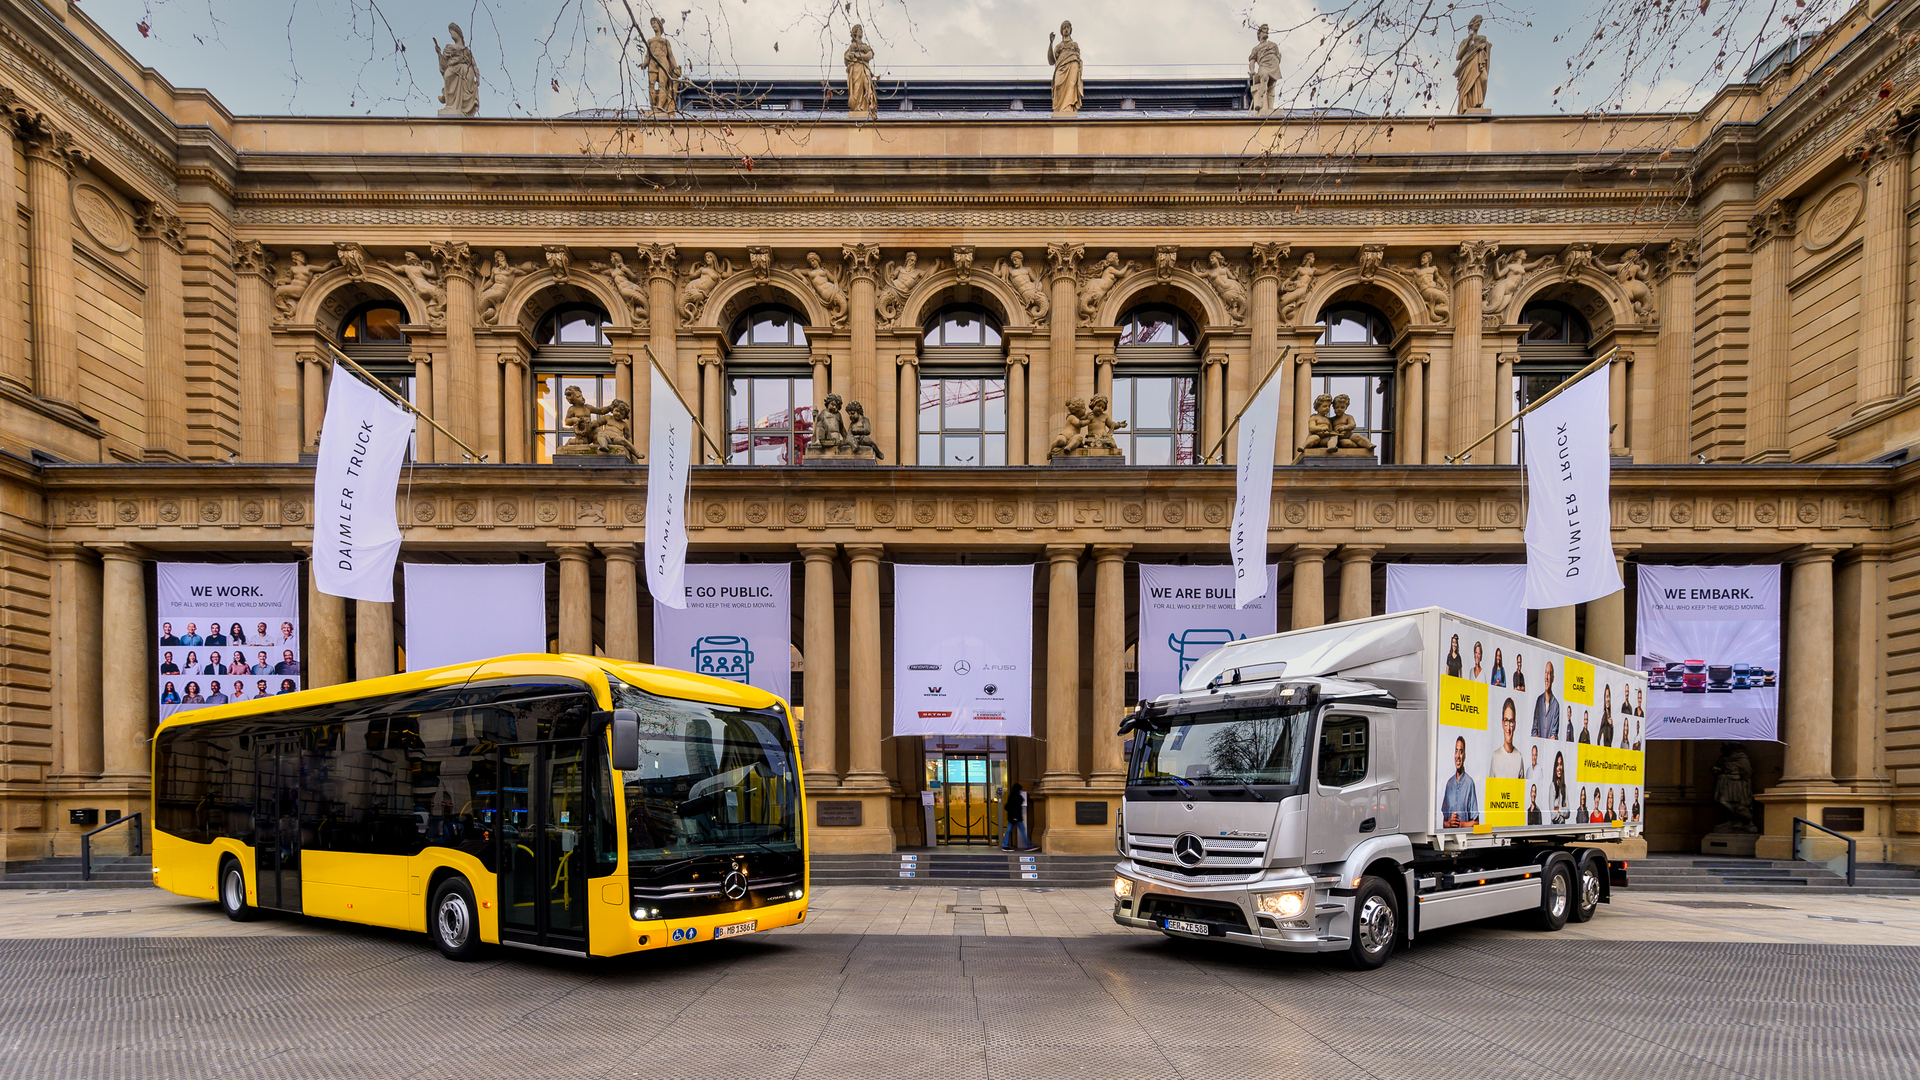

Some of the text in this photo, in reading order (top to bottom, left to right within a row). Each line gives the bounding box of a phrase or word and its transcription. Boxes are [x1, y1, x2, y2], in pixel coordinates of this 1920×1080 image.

[338, 420, 374, 571] DAIMLER TRUCK
[658, 493, 673, 576] DAIMLER
[191, 586, 264, 597] WE WORK.
[696, 587, 716, 598] GO
[720, 587, 773, 598] PUBLIC.
[1150, 588, 1172, 598] WE
[1175, 588, 1201, 599] ARE
[1664, 588, 1754, 600] WE EMBARK.
[1576, 676, 1584, 684] WE
[1460, 694, 1470, 703] WE
[1663, 716, 1750, 724] #WeAreDaimlerTruck
[1584, 759, 1637, 771] #WeAreDaimlerTruck
[1500, 792, 1510, 800] WE
[1490, 801, 1520, 809] INNOVATE.
